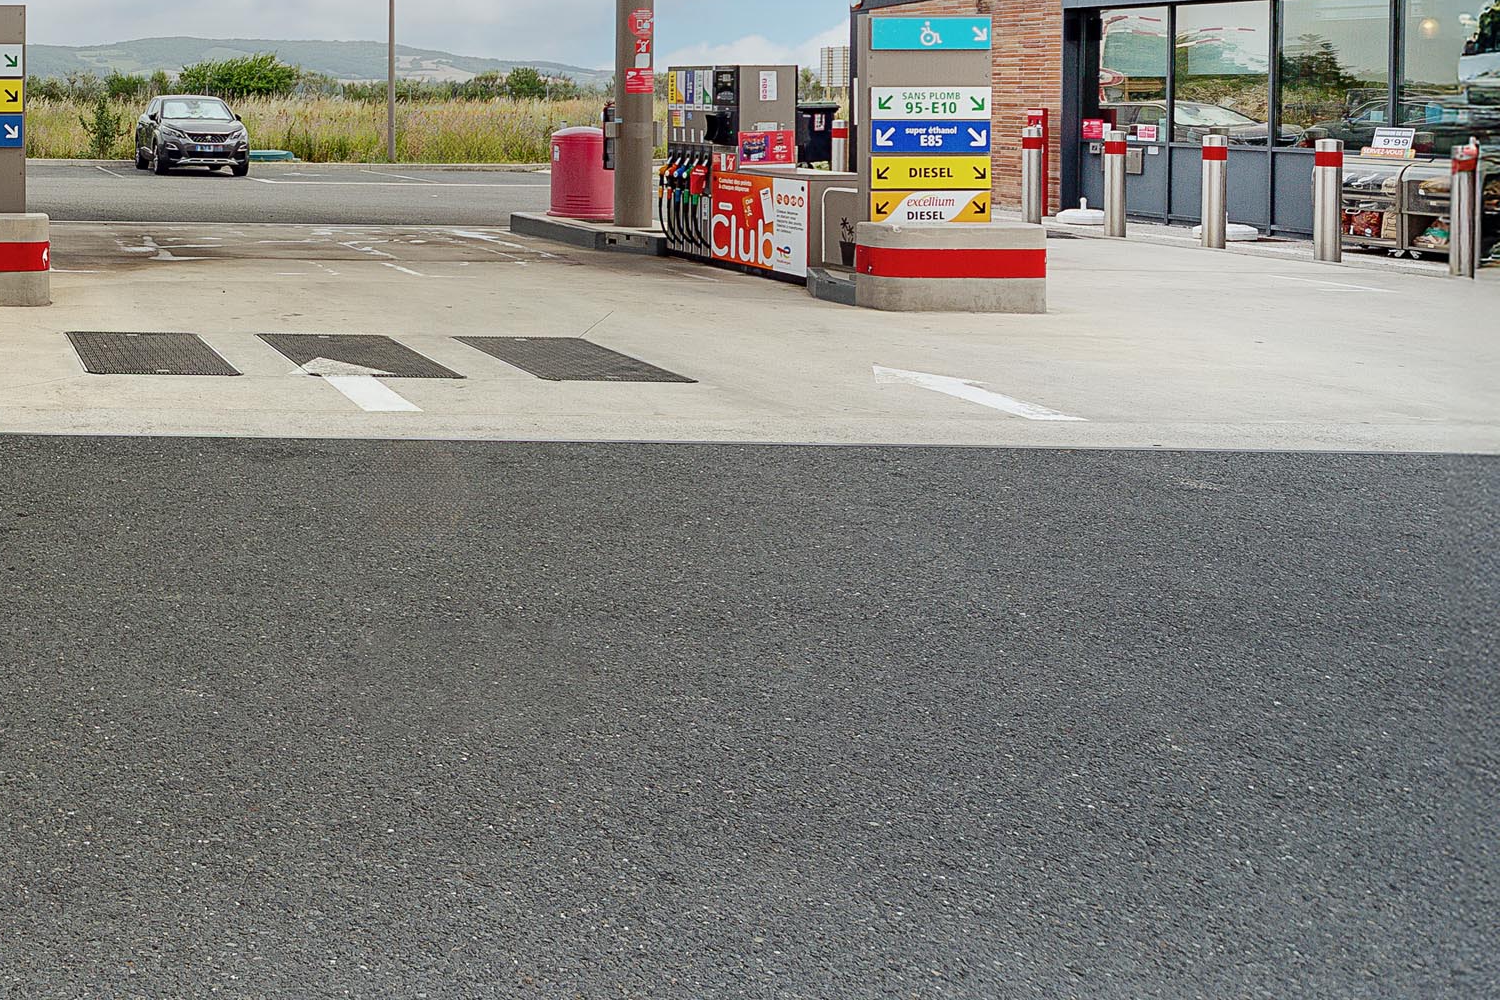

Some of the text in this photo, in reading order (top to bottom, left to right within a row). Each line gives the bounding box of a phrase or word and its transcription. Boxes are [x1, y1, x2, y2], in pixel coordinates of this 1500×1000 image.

[902, 92, 961, 100] SANS PLOMB
[905, 102, 957, 114] 95-E10
[905, 126, 958, 136] super éthanol
[920, 135, 943, 147] E85
[909, 167, 953, 178] DIESEL
[906, 196, 955, 207] excellium
[907, 211, 945, 220] DIESEL
[711, 213, 774, 267] Club
